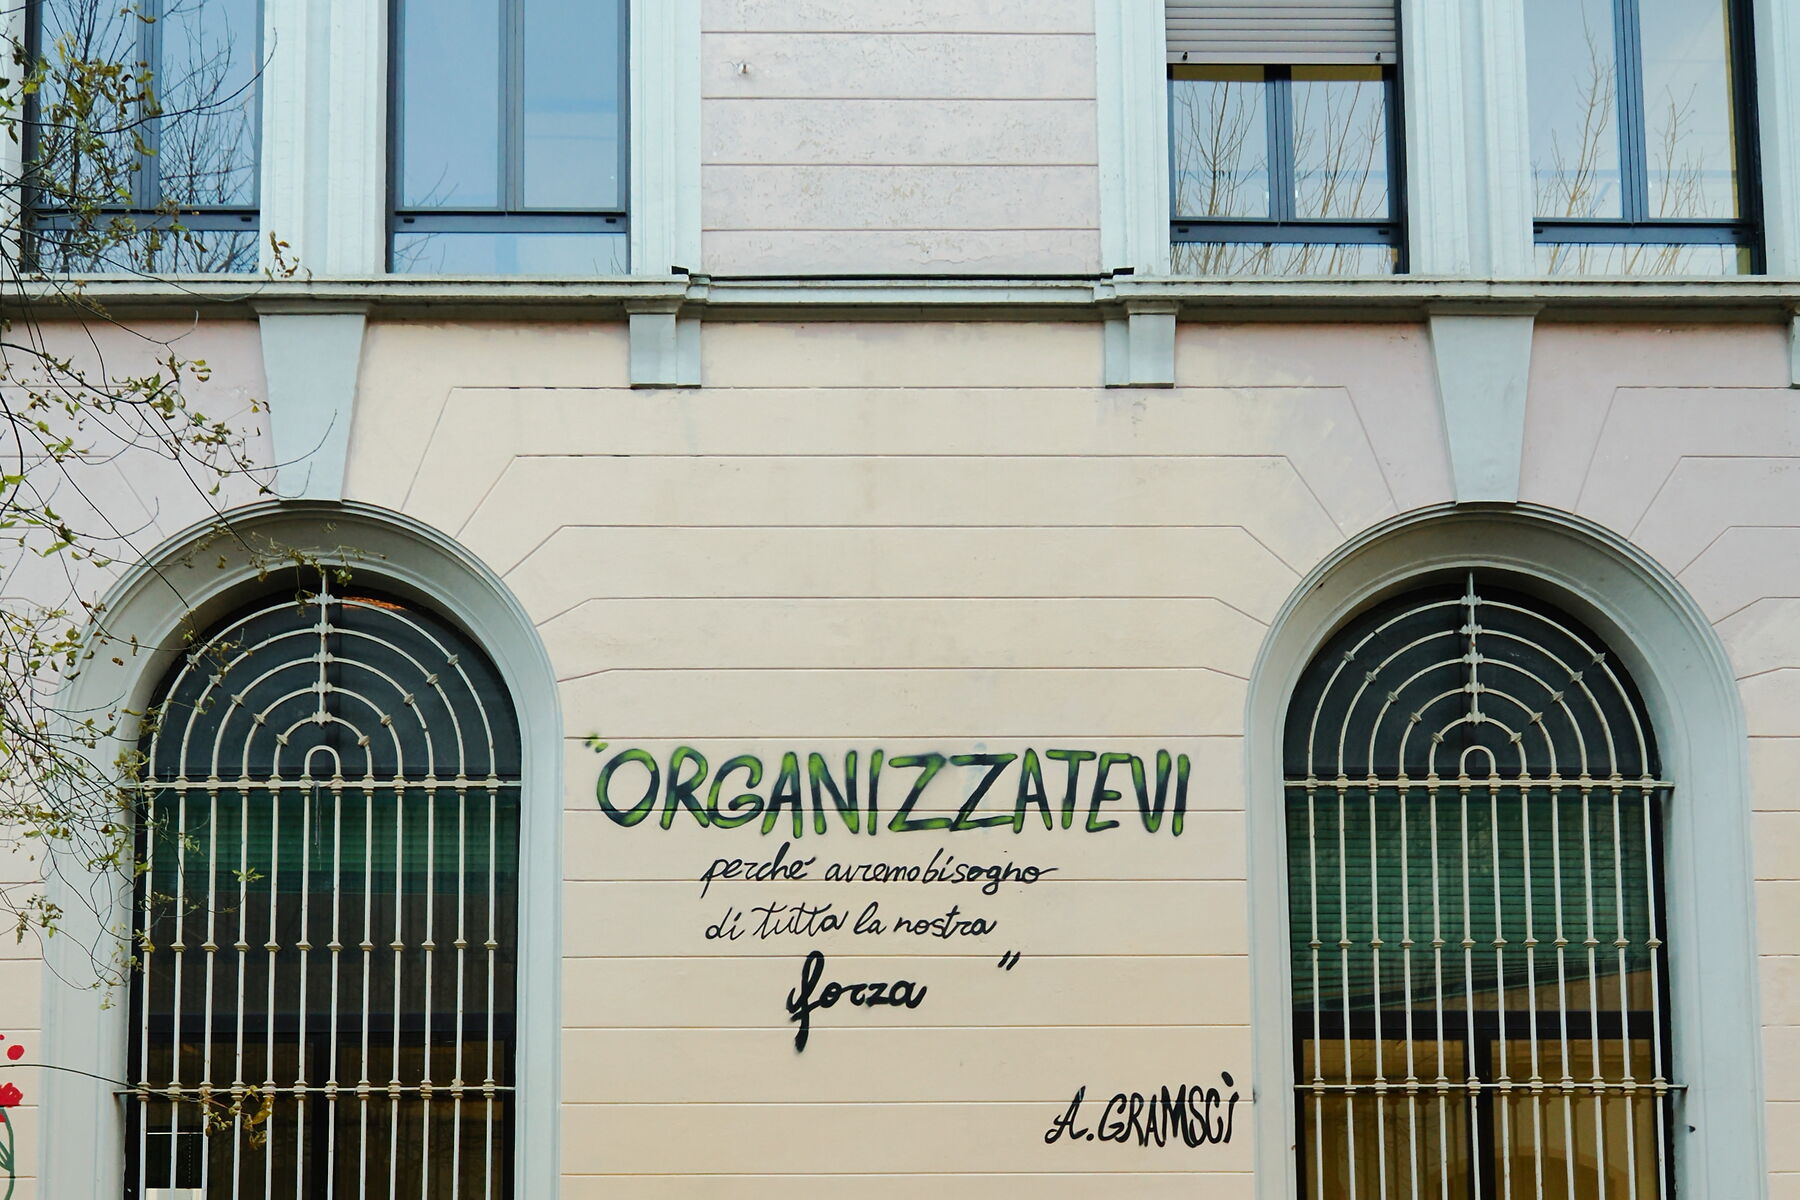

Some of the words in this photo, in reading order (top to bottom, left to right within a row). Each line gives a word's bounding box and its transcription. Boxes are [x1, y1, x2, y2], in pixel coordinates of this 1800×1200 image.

[705, 906, 746, 941] di
[750, 902, 849, 940] tutta
[853, 902, 887, 936] la
[893, 905, 998, 940] nostra
